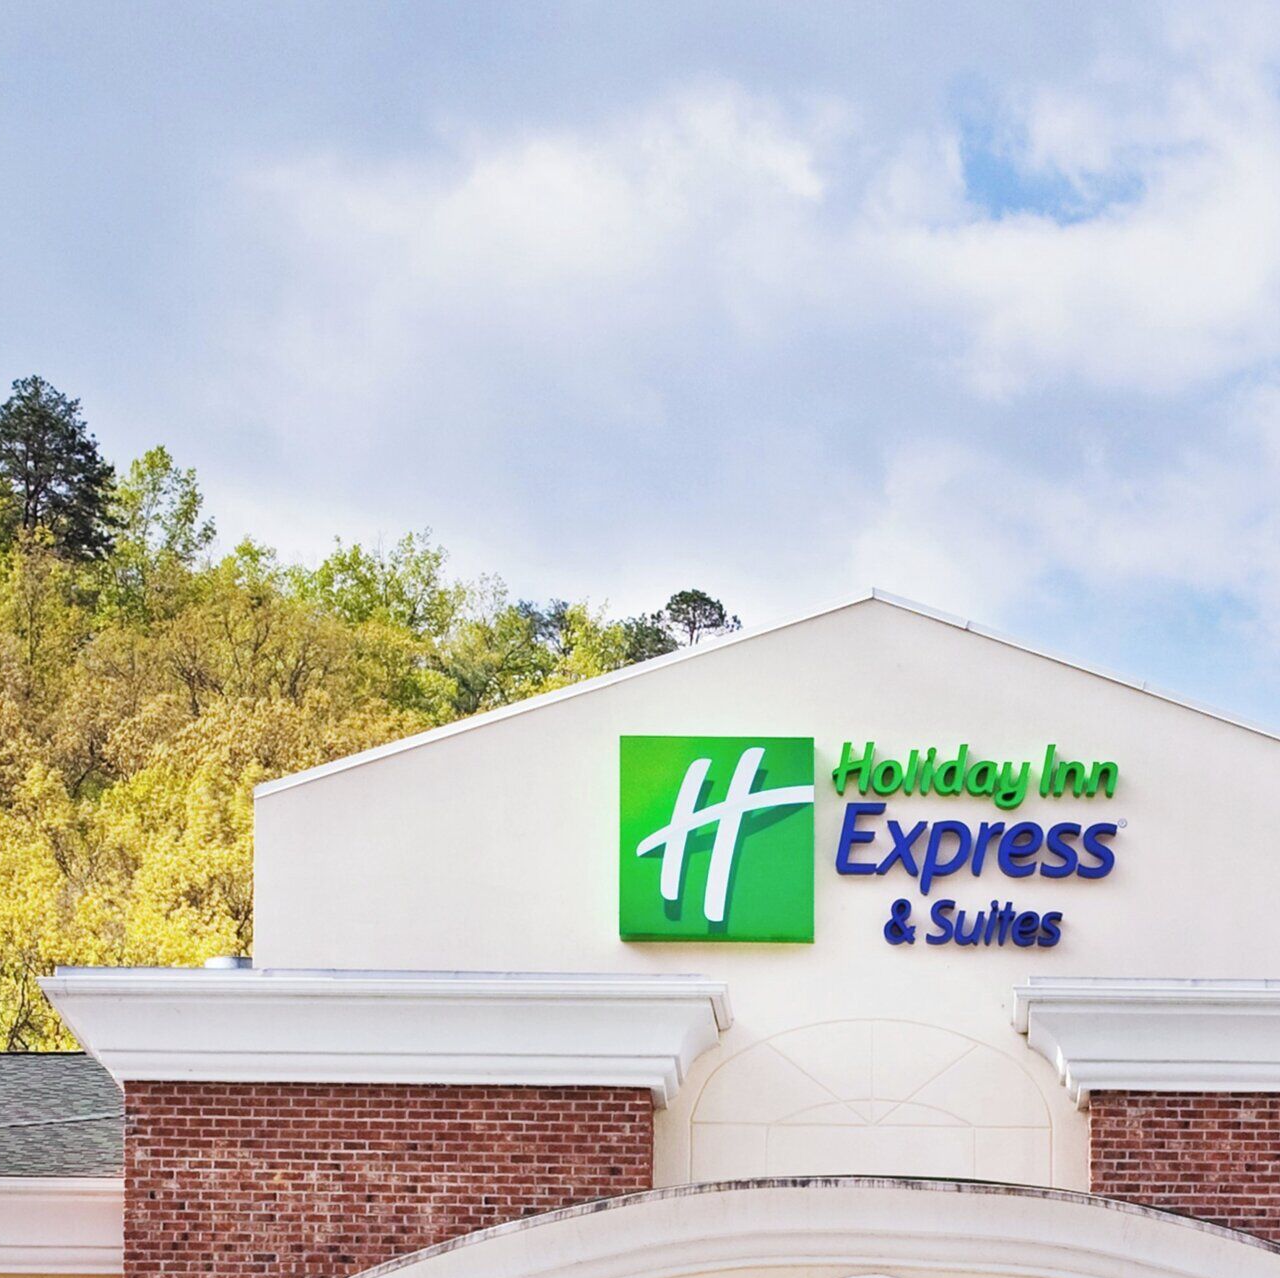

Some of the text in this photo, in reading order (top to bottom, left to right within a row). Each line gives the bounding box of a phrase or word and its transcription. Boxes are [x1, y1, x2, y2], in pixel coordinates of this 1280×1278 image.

[832, 741, 1118, 810] Holiday Inn
[835, 802, 1118, 896] Express
[883, 898, 1063, 947] & Suites
